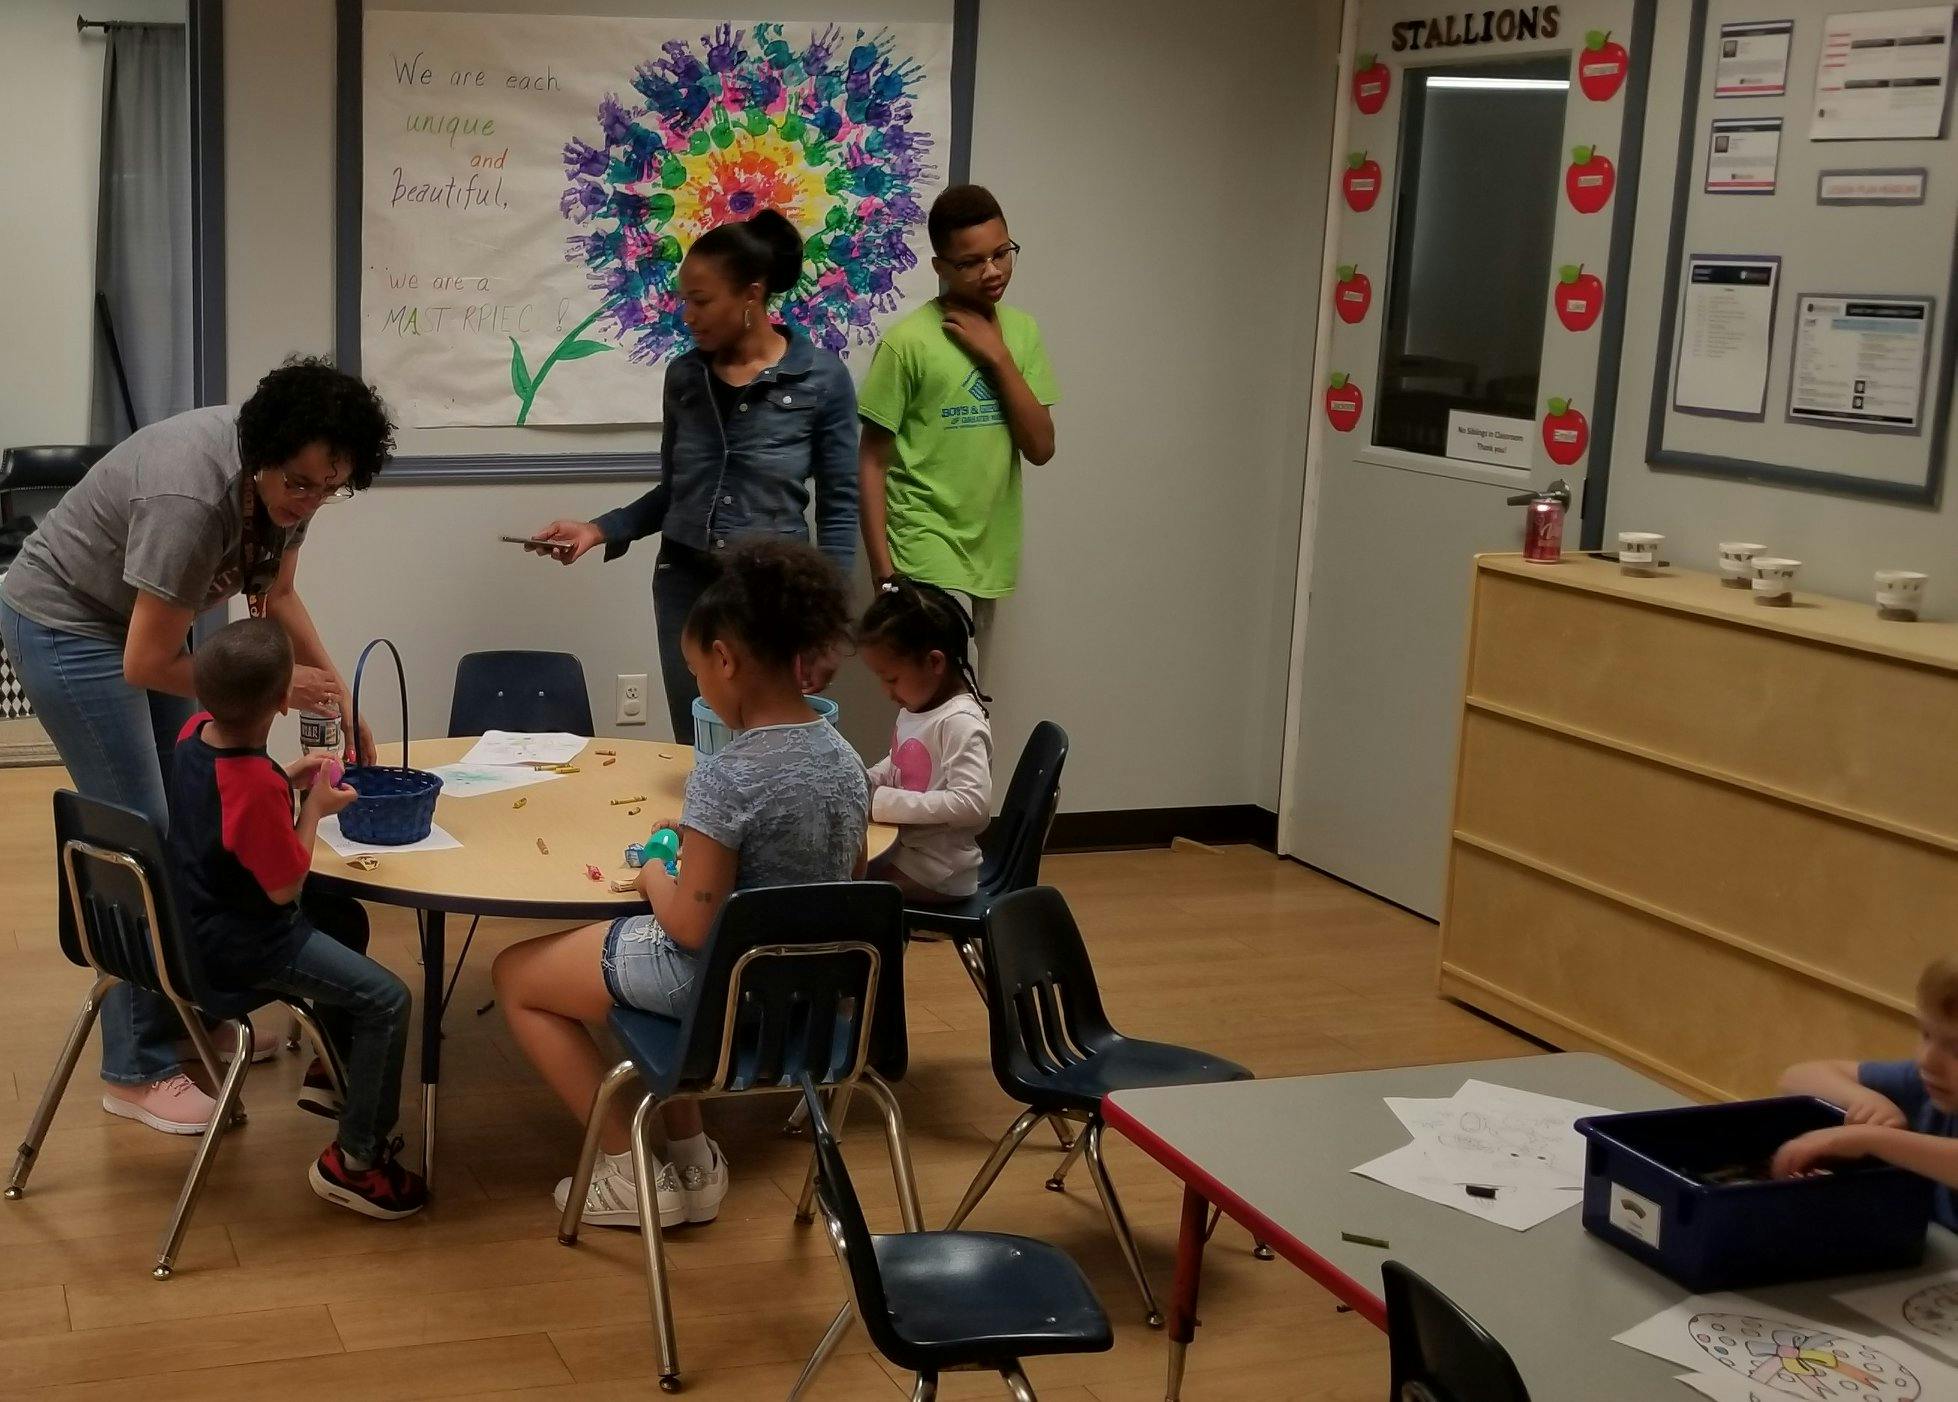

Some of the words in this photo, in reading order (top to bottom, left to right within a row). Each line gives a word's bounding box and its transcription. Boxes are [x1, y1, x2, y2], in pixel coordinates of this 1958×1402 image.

[1391, 5, 1559, 52] STALLIONS
[391, 51, 432, 85] We
[450, 70, 485, 86] are
[505, 66, 561, 92] each
[406, 114, 496, 149] unique
[470, 147, 508, 170] and
[391, 166, 508, 210] beautiful,
[433, 275, 464, 291] are
[477, 277, 490, 292] a
[942, 406, 969, 417] BOYS
[970, 406, 978, 414] &
[1458, 426, 1466, 434] No
[1467, 427, 1488, 438] Siblings
[1494, 431, 1524, 442] Classroom
[1477, 442, 1493, 452] Thank
